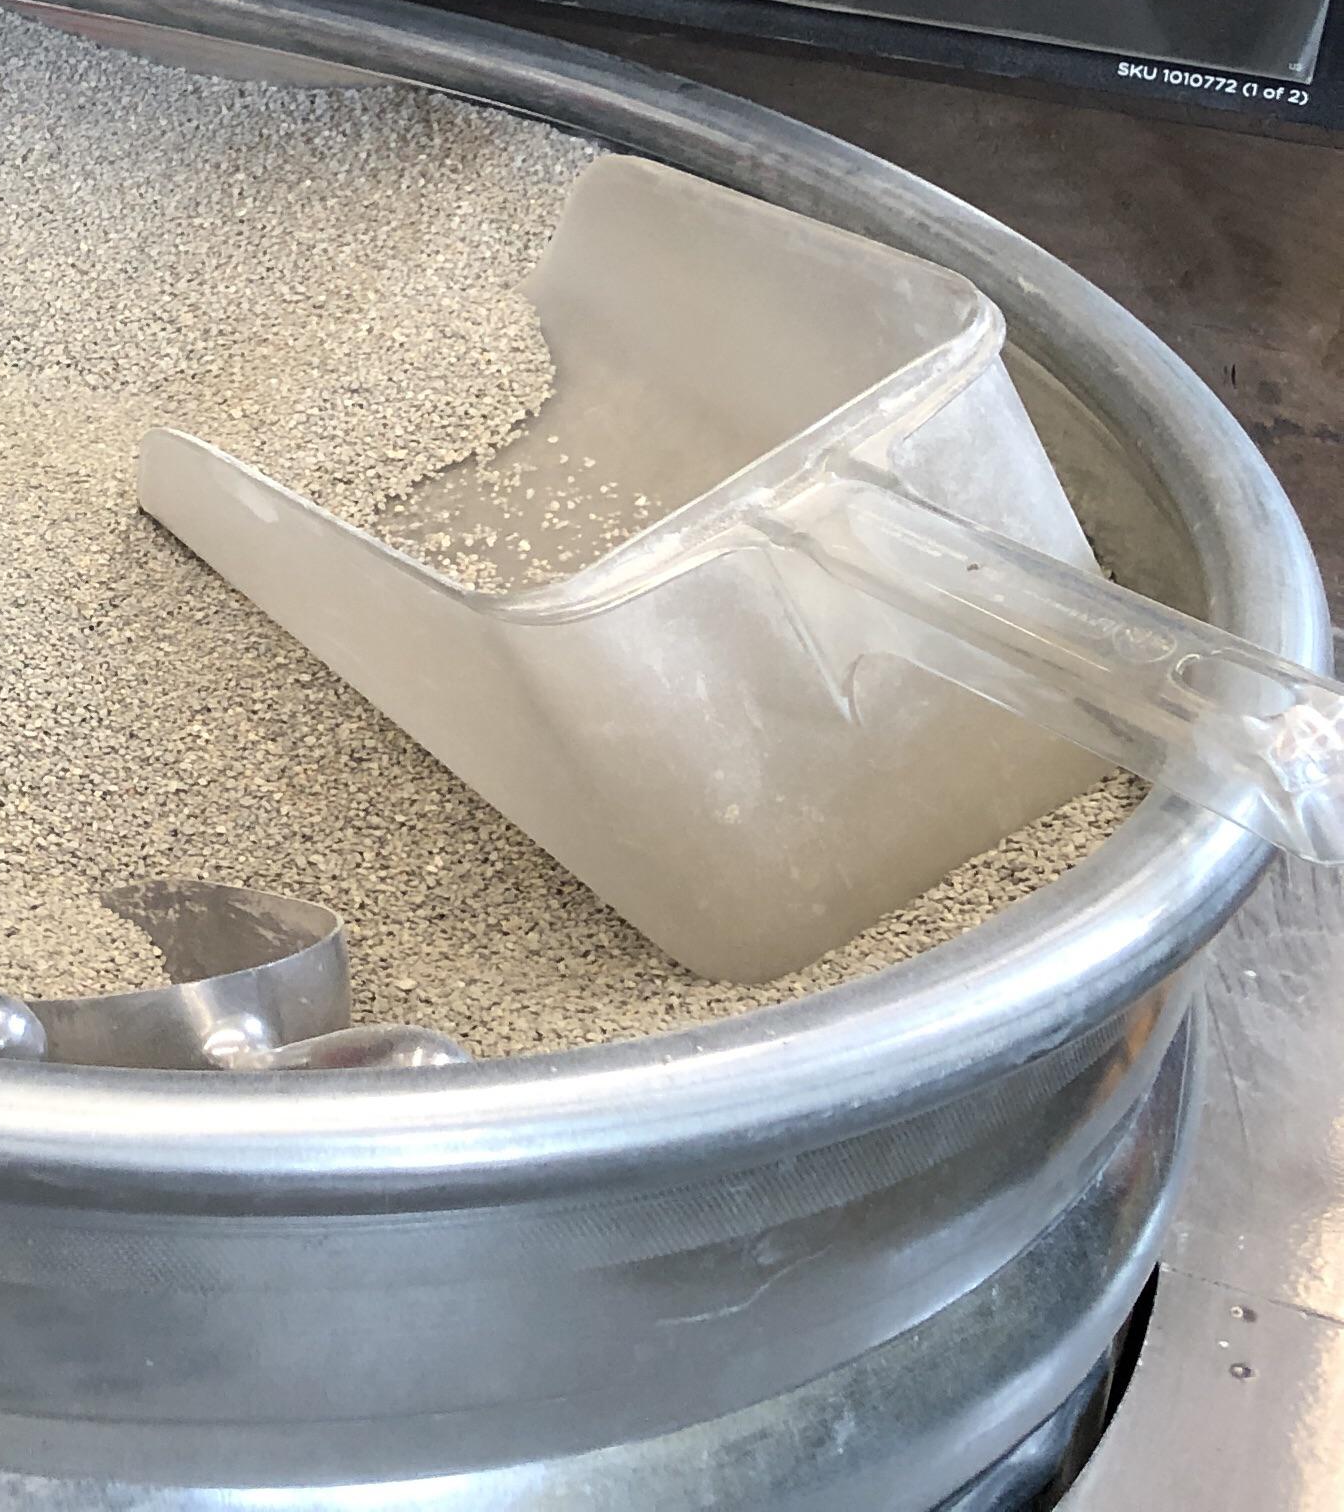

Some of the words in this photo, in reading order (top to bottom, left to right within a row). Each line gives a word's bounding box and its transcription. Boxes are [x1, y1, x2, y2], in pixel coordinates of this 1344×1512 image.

[1117, 61, 1158, 81] SKU
[1163, 69, 1238, 94] 1010772
[1242, 82, 1258, 98] (1
[1262, 87, 1285, 100] of
[1287, 89, 1309, 106] 2)
